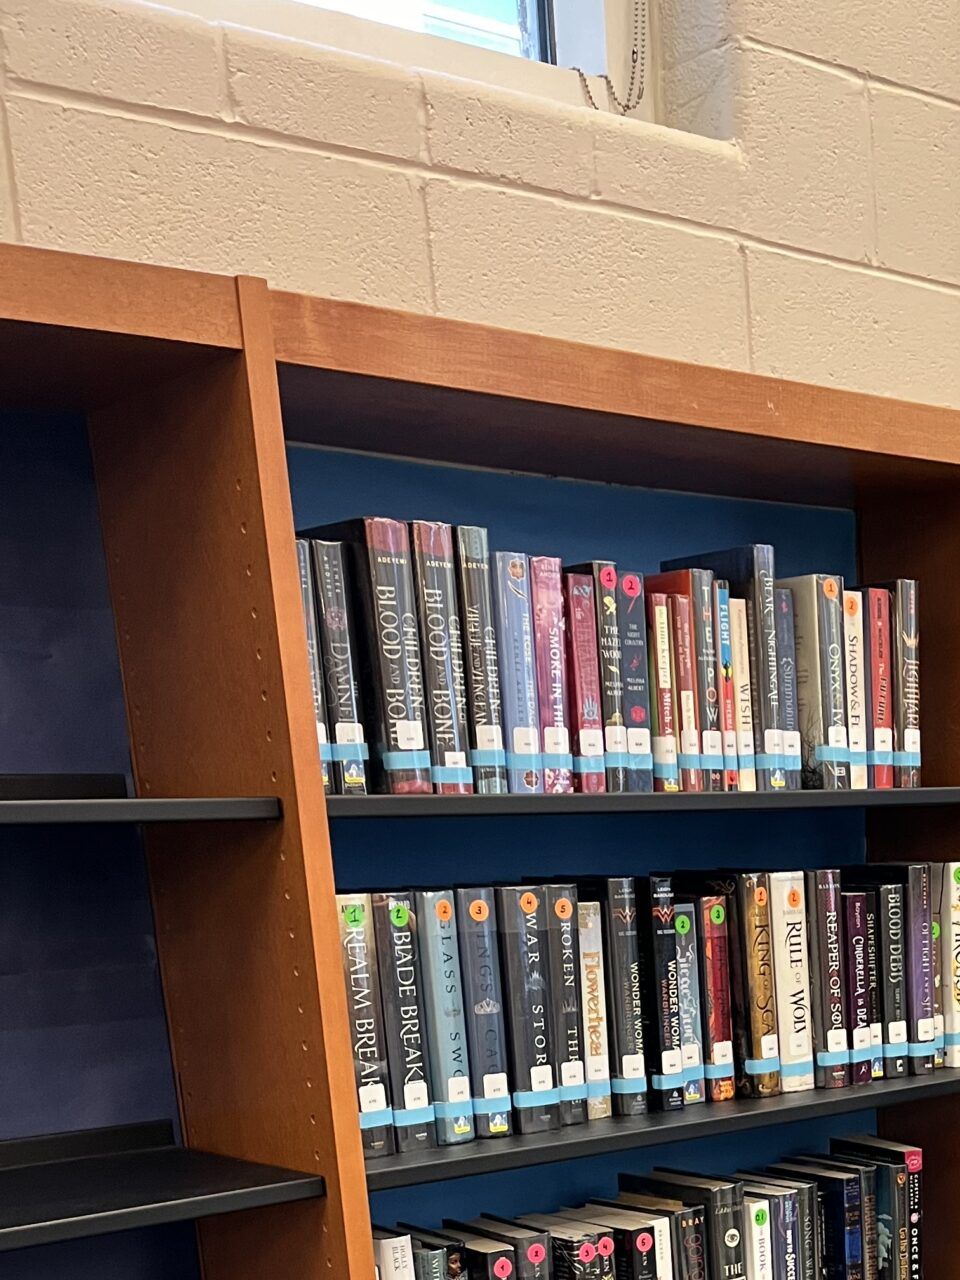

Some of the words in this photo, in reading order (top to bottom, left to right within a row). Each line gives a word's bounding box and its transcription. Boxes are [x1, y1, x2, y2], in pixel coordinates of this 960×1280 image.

[376, 585, 402, 659] BLOOD
[424, 588, 449, 662] BLOOD
[720, 604, 730, 646] FLIGHT
[401, 612, 423, 708] CHILDREN
[549, 627, 562, 677] SMOKE
[829, 643, 841, 690] ONYX
[848, 634, 859, 697] SHADOW
[552, 683, 562, 698] IN
[432, 689, 457, 747] BONE
[349, 908, 359, 923] 1
[395, 909, 402, 919] 2
[475, 905, 482, 914] 3
[526, 897, 532, 906] 4
[560, 904, 566, 913] 5
[681, 920, 686, 929] 2
[715, 909, 721, 919] 3
[887, 893, 901, 941] BLOOD
[440, 922, 457, 994] GLASS
[525, 911, 540, 964] WAR
[753, 924, 772, 976] KING
[785, 921, 804, 968] RULE
[826, 911, 841, 973] REAPER
[866, 913, 878, 990] SHAPESHIFTER
[344, 927, 373, 1010] REALM
[394, 931, 417, 998] BLADE
[667, 960, 679, 1013] WONDER
[830, 977, 841, 998] OF
[853, 935, 866, 996] CINDERELLA
[630, 962, 643, 1016] WONDER
[660, 978, 671, 1047] WARBRINGER
[682, 1216, 705, 1228] BRAY
[803, 1215, 812, 1249] SONG
[724, 1261, 743, 1276] THE
[758, 1237, 767, 1272] BOOK
[911, 1262, 919, 1271] &
